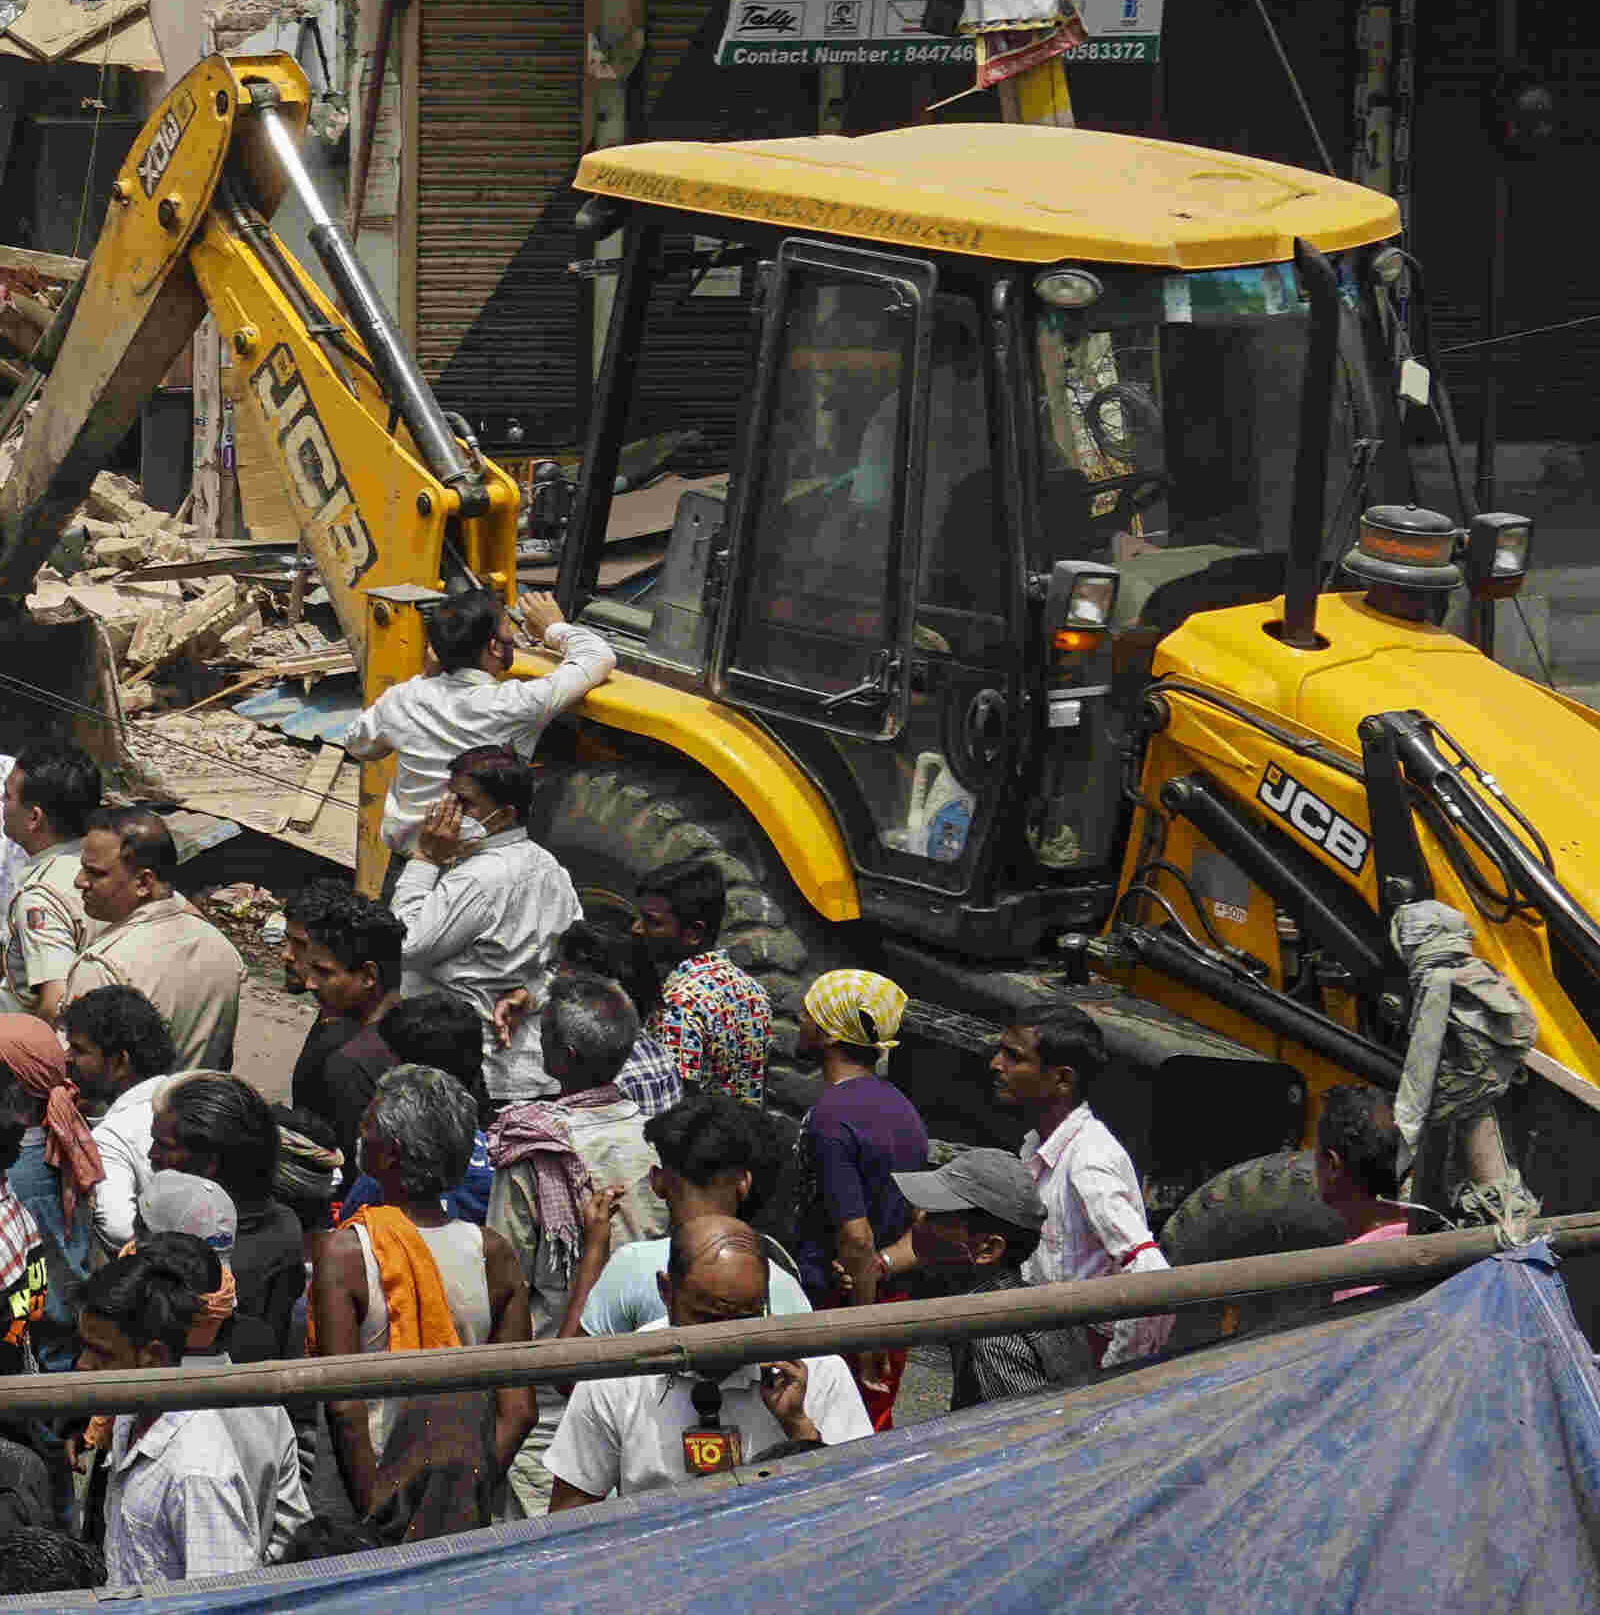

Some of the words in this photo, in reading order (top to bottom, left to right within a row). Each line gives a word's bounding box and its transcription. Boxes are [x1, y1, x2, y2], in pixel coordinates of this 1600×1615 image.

[740, 5, 798, 33] Tally
[734, 47, 808, 66] Contact
[813, 46, 890, 66] Number
[904, 45, 978, 66] 844746
[1065, 41, 1145, 60] 0583372
[1261, 779, 1370, 870] JCB
[692, 1440, 721, 1464] 10
